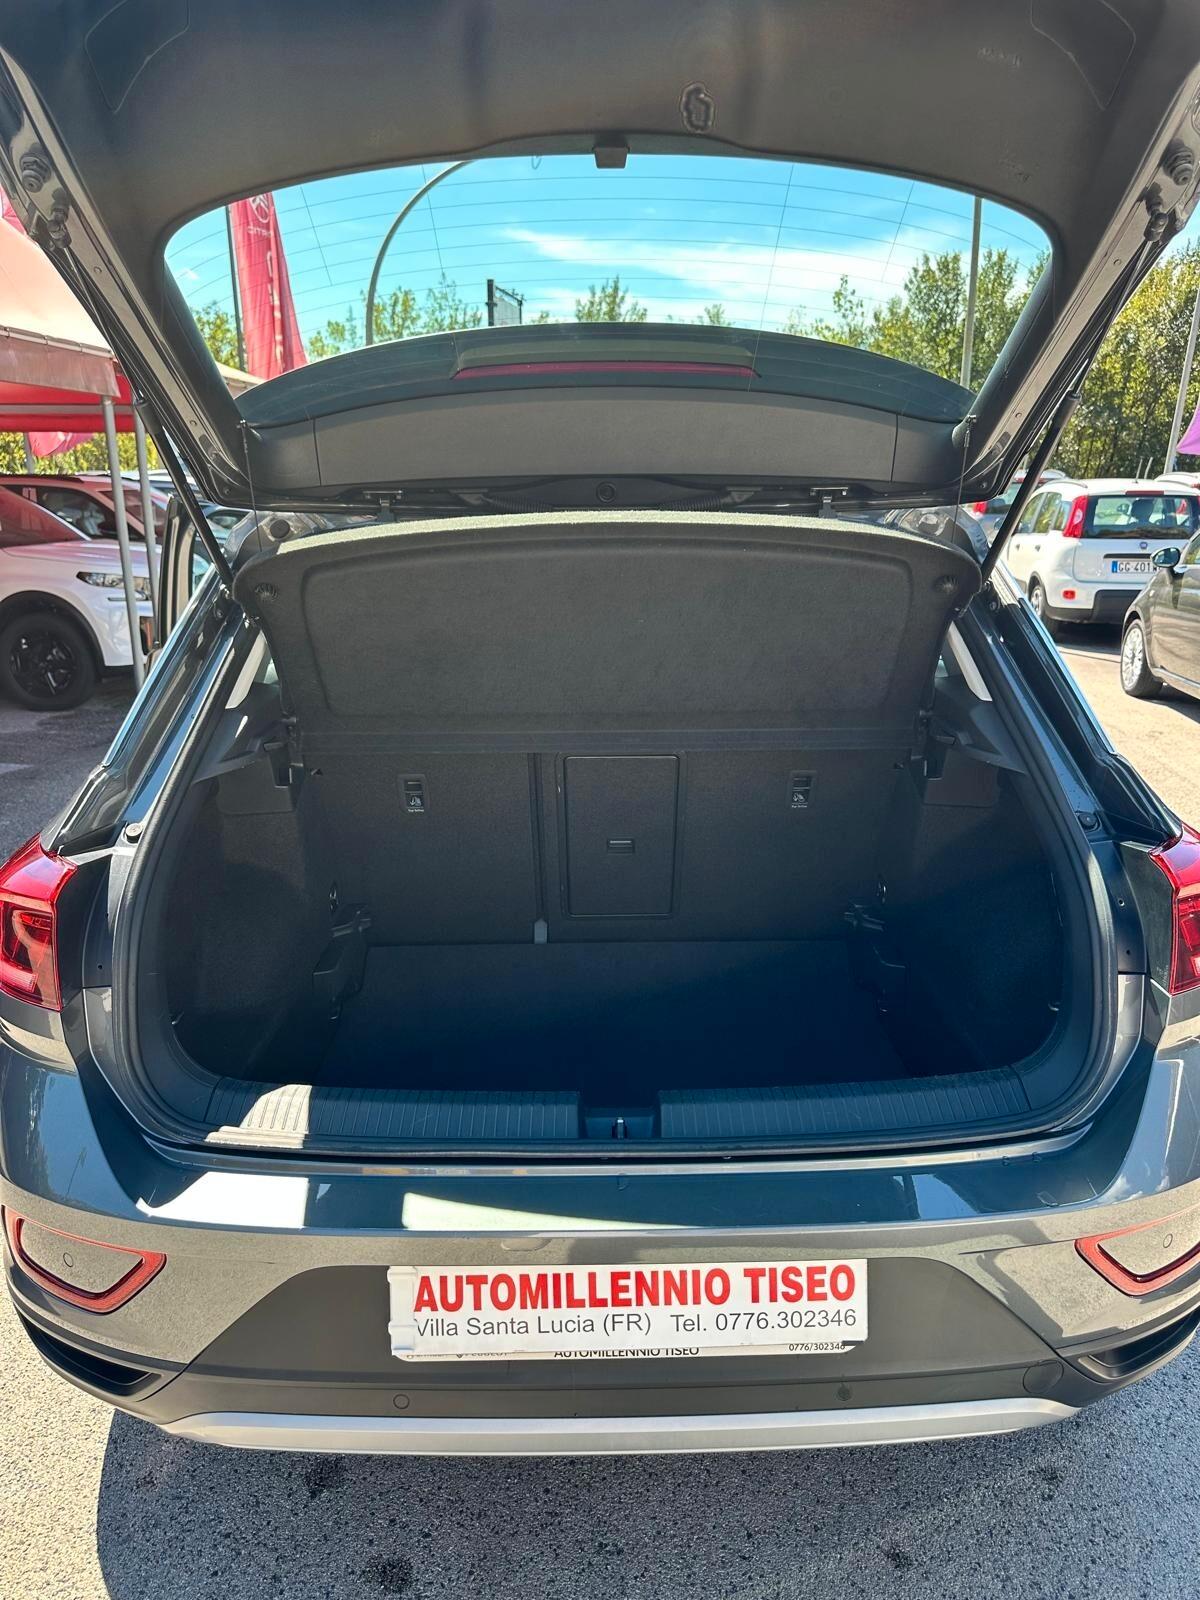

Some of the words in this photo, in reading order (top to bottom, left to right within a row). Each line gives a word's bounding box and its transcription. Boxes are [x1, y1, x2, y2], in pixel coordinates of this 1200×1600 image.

[413, 1267, 731, 1312] AUTOMILLENNIO
[743, 1264, 856, 1304] TISEO
[416, 1317, 459, 1337] Villa
[466, 1316, 530, 1336] Santa
[537, 1314, 595, 1335] Lucia
[603, 1312, 651, 1337] (FR)
[670, 1313, 707, 1333] Tel.
[715, 1308, 857, 1331] 0776.302346
